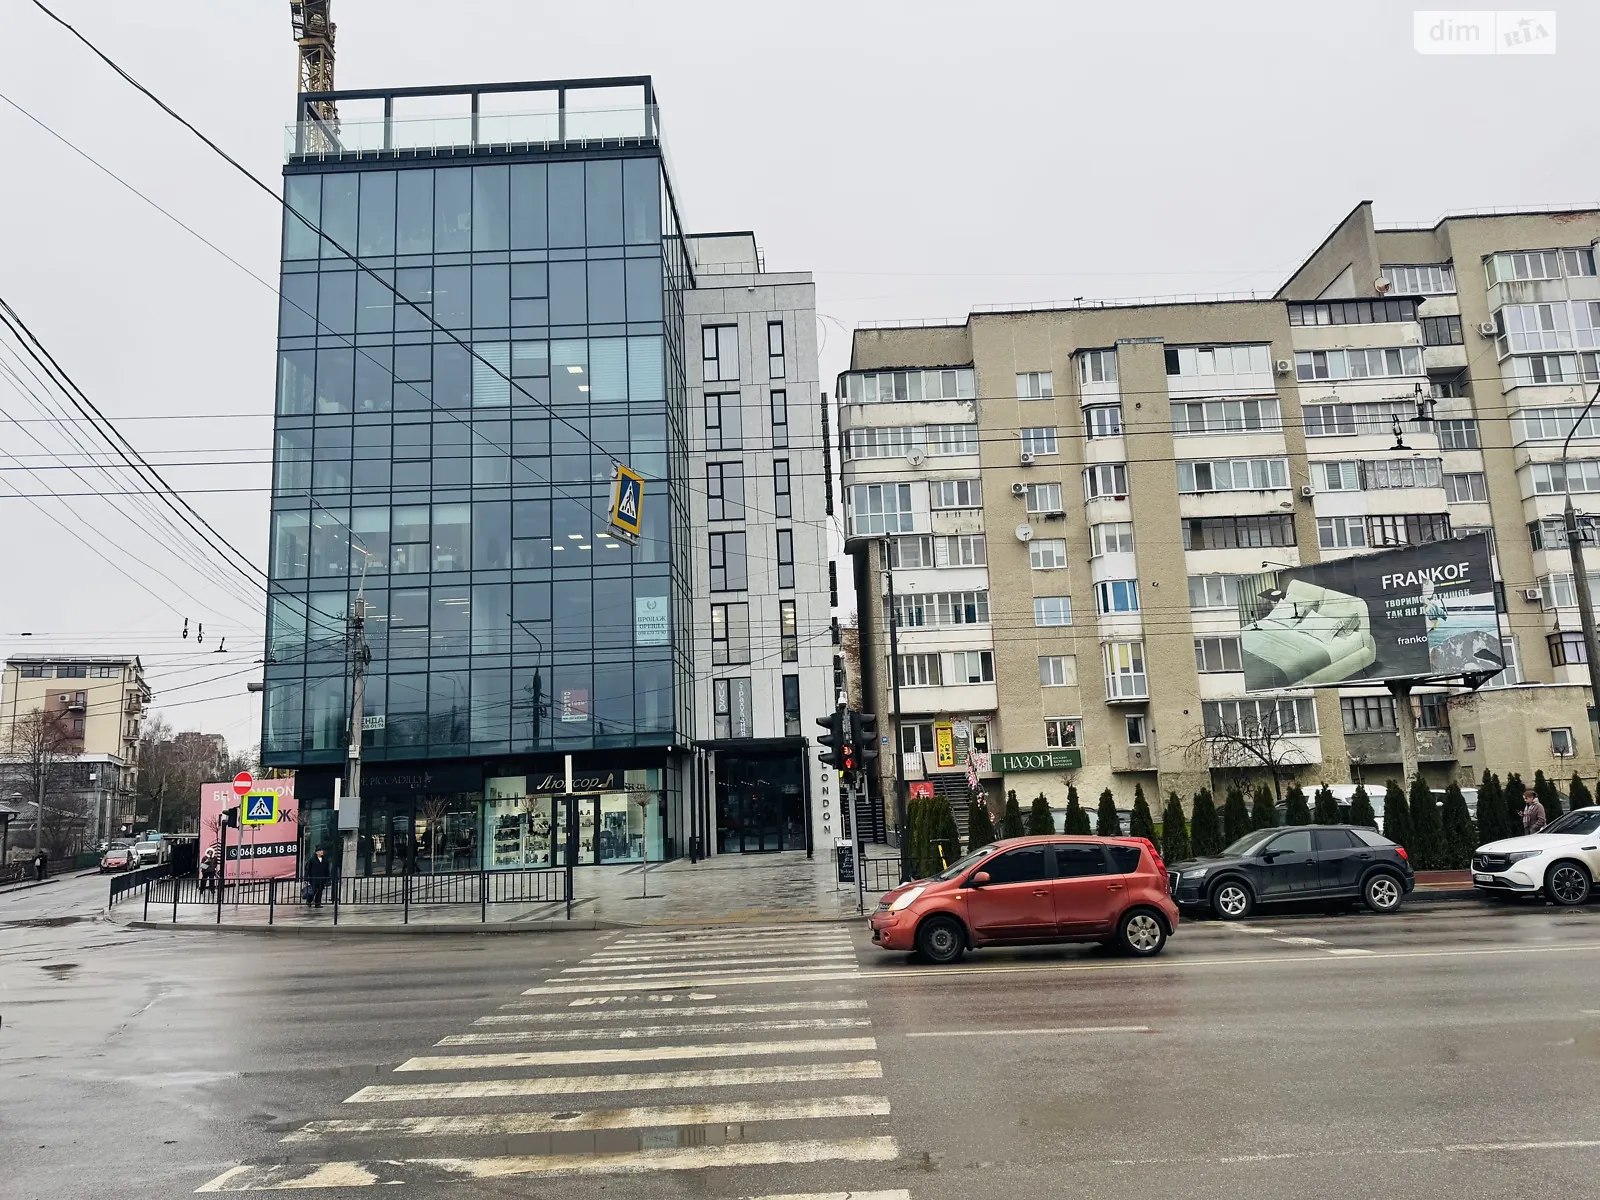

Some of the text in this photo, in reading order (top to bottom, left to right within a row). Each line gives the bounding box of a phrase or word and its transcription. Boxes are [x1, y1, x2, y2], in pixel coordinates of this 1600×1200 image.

[1381, 562, 1470, 590] FRANKOF
[1386, 609, 1403, 620] ТАК
[1405, 608, 1417, 617] ЯК
[1397, 634, 1428, 645] franko
[256, 846, 272, 855] 884
[274, 845, 285, 854] 18
[286, 844, 298, 853] 88
